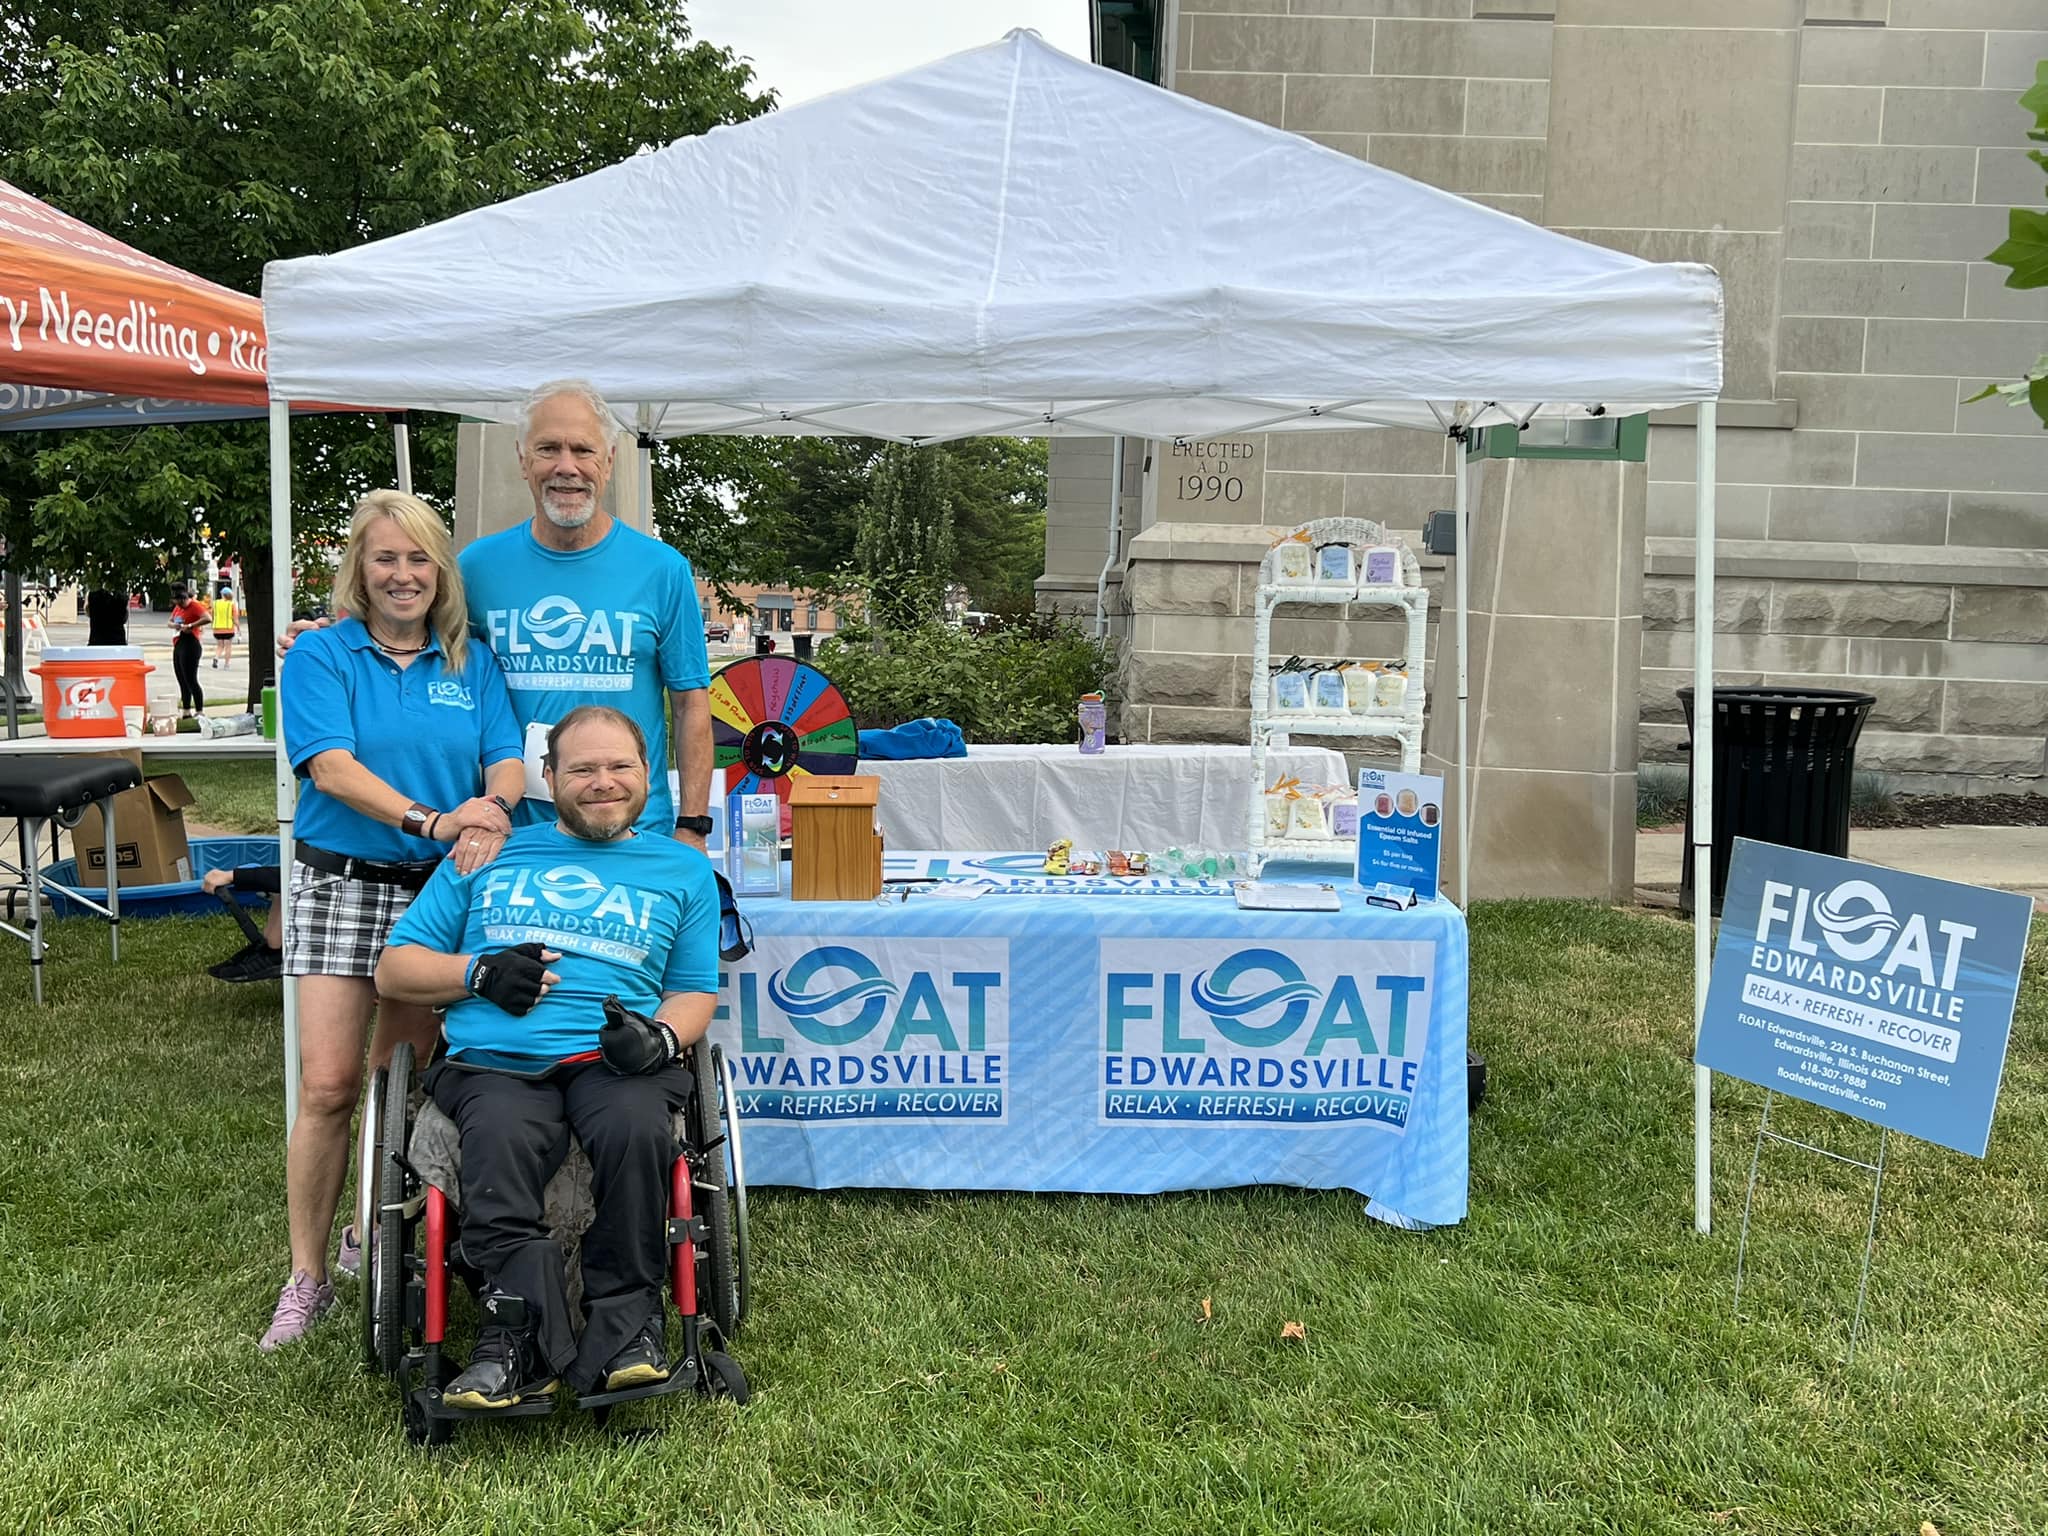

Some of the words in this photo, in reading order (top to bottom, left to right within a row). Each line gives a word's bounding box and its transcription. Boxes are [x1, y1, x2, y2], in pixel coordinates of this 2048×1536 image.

[0, 296, 28, 351] y
[40, 287, 207, 375] Needling
[1172, 442, 1254, 459] ERECTED
[1177, 475, 1243, 502] 1990
[487, 594, 640, 656] FLOAT
[499, 655, 636, 673] DWARDSVILLE
[428, 681, 471, 701] FLOAT
[531, 677, 573, 688] REFRESH
[1362, 771, 1386, 782] FLOAT
[744, 798, 772, 808] FLOAT
[1367, 824, 1395, 834] Essential
[1407, 829, 1432, 839] Infused
[1379, 832, 1401, 842] Epsom
[1402, 836, 1418, 845] Salts
[1389, 861, 1400, 869] five
[1402, 852, 1413, 861] bag
[483, 865, 661, 930] FLOAT
[482, 907, 654, 950] EDWARDSVILLE
[525, 930, 579, 948] REFRESH
[1756, 880, 1977, 991] FLOAT
[1751, 946, 1965, 1023] EDWARDSVILLE
[718, 946, 1001, 1053] LOAT
[1106, 948, 1425, 1057] FLOAT
[1748, 983, 1792, 1007] RELAX
[1803, 998, 1865, 1028] REFRESH
[1878, 1019, 1952, 1052] RECOVER
[1738, 1014, 1766, 1029] FLOAT
[1767, 1021, 1827, 1049] Edwardsville,
[1830, 1041, 1848, 1055] 224
[1850, 1046, 1858, 1057] S.
[1861, 1050, 1915, 1076] Buchanan
[1917, 1065, 1951, 1088] Street,
[1774, 1038, 1835, 1067] Edwardsville,
[1838, 1057, 1869, 1076] Illinois
[1871, 1068, 1903, 1086] 62025
[1106, 1056, 1417, 1093] EDWARDSVILLE
[1777, 1067, 1887, 1110] floatedwardsville.com
[1800, 1060, 1867, 1089] 618-307-9888
[780, 1094, 876, 1115] REFRESH
[897, 1093, 999, 1112] RECOVER
[1108, 1095, 1179, 1114] RELAX
[1198, 1095, 1294, 1117] REFRESH
[1314, 1095, 1409, 1122] RECOVER
